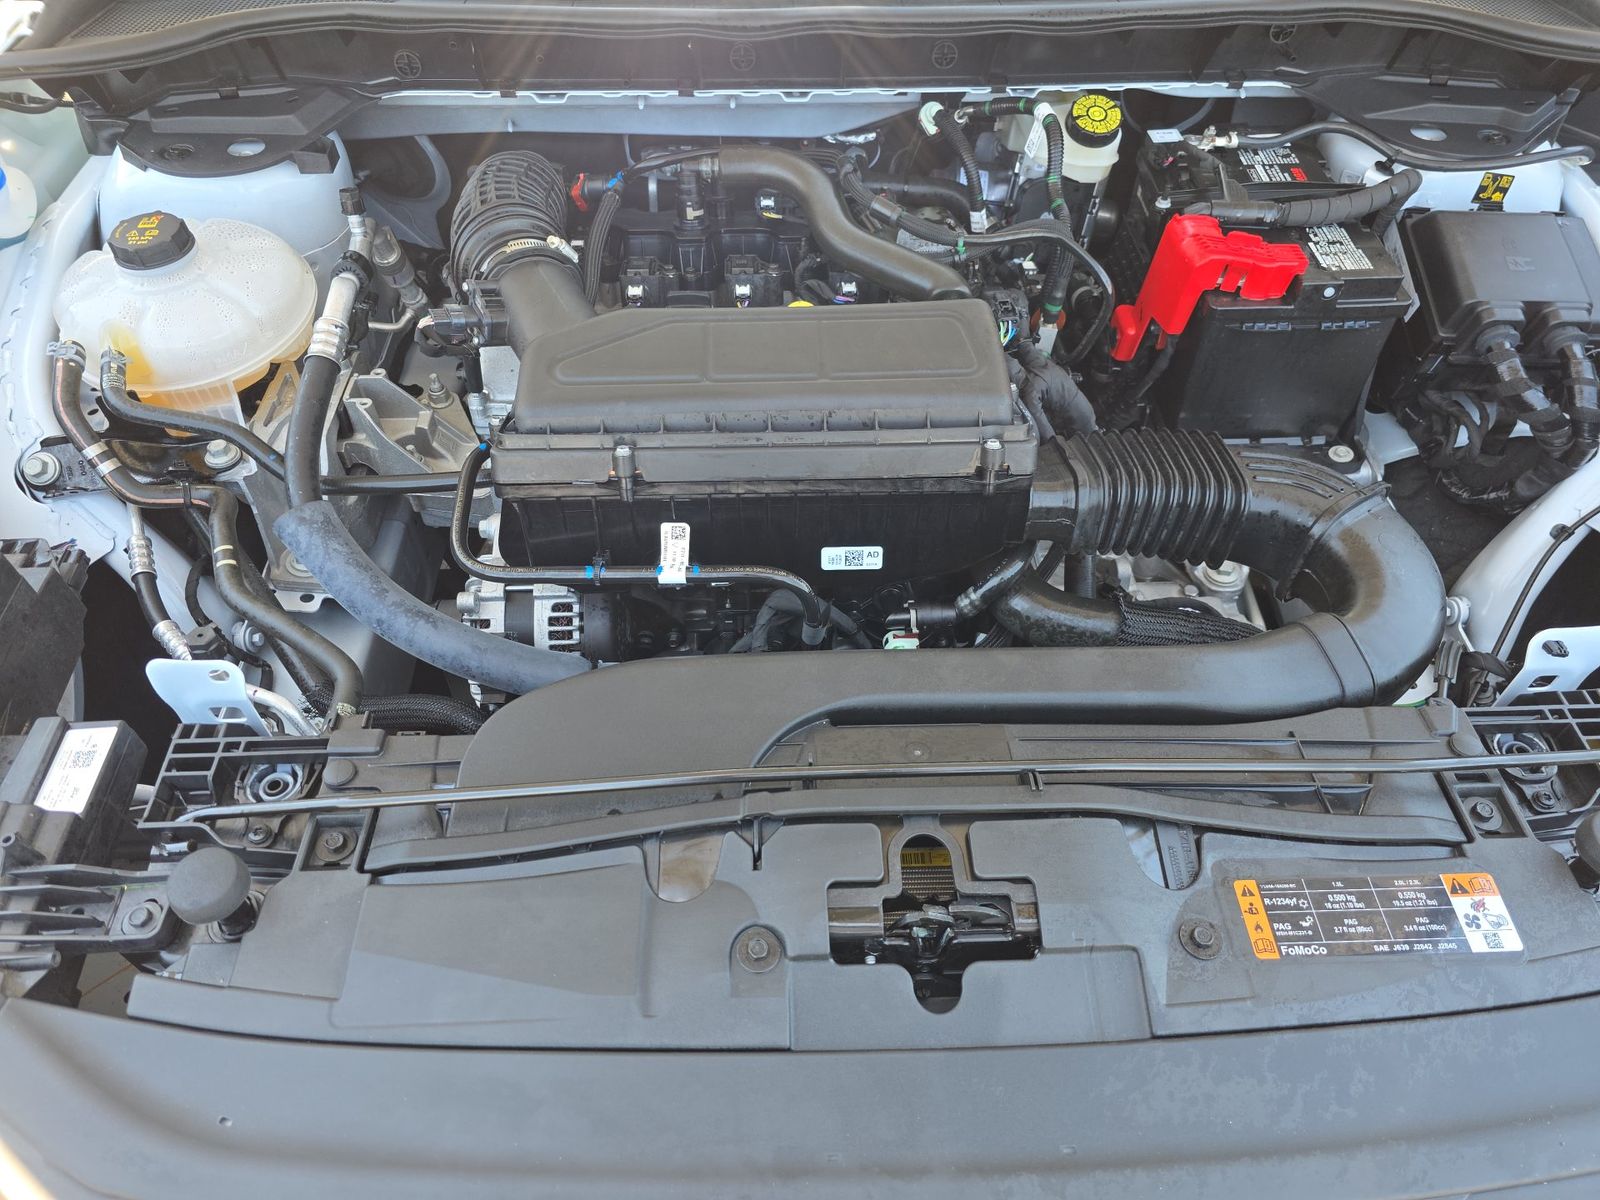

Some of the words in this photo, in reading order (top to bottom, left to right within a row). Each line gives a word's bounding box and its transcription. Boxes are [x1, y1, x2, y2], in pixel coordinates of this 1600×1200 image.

[1327, 893, 1346, 902] 0.500
[1346, 893, 1357, 903] kg
[1397, 891, 1416, 899] 0.550
[1416, 891, 1427, 900] kg
[1263, 897, 1297, 906] R-1234yf
[1412, 899, 1426, 907] (1.21
[1414, 916, 1430, 924] PAG
[1425, 923, 1447, 932] (100cc)
[1280, 945, 1328, 955] FoMoCo
[1373, 944, 1390, 952] SAE
